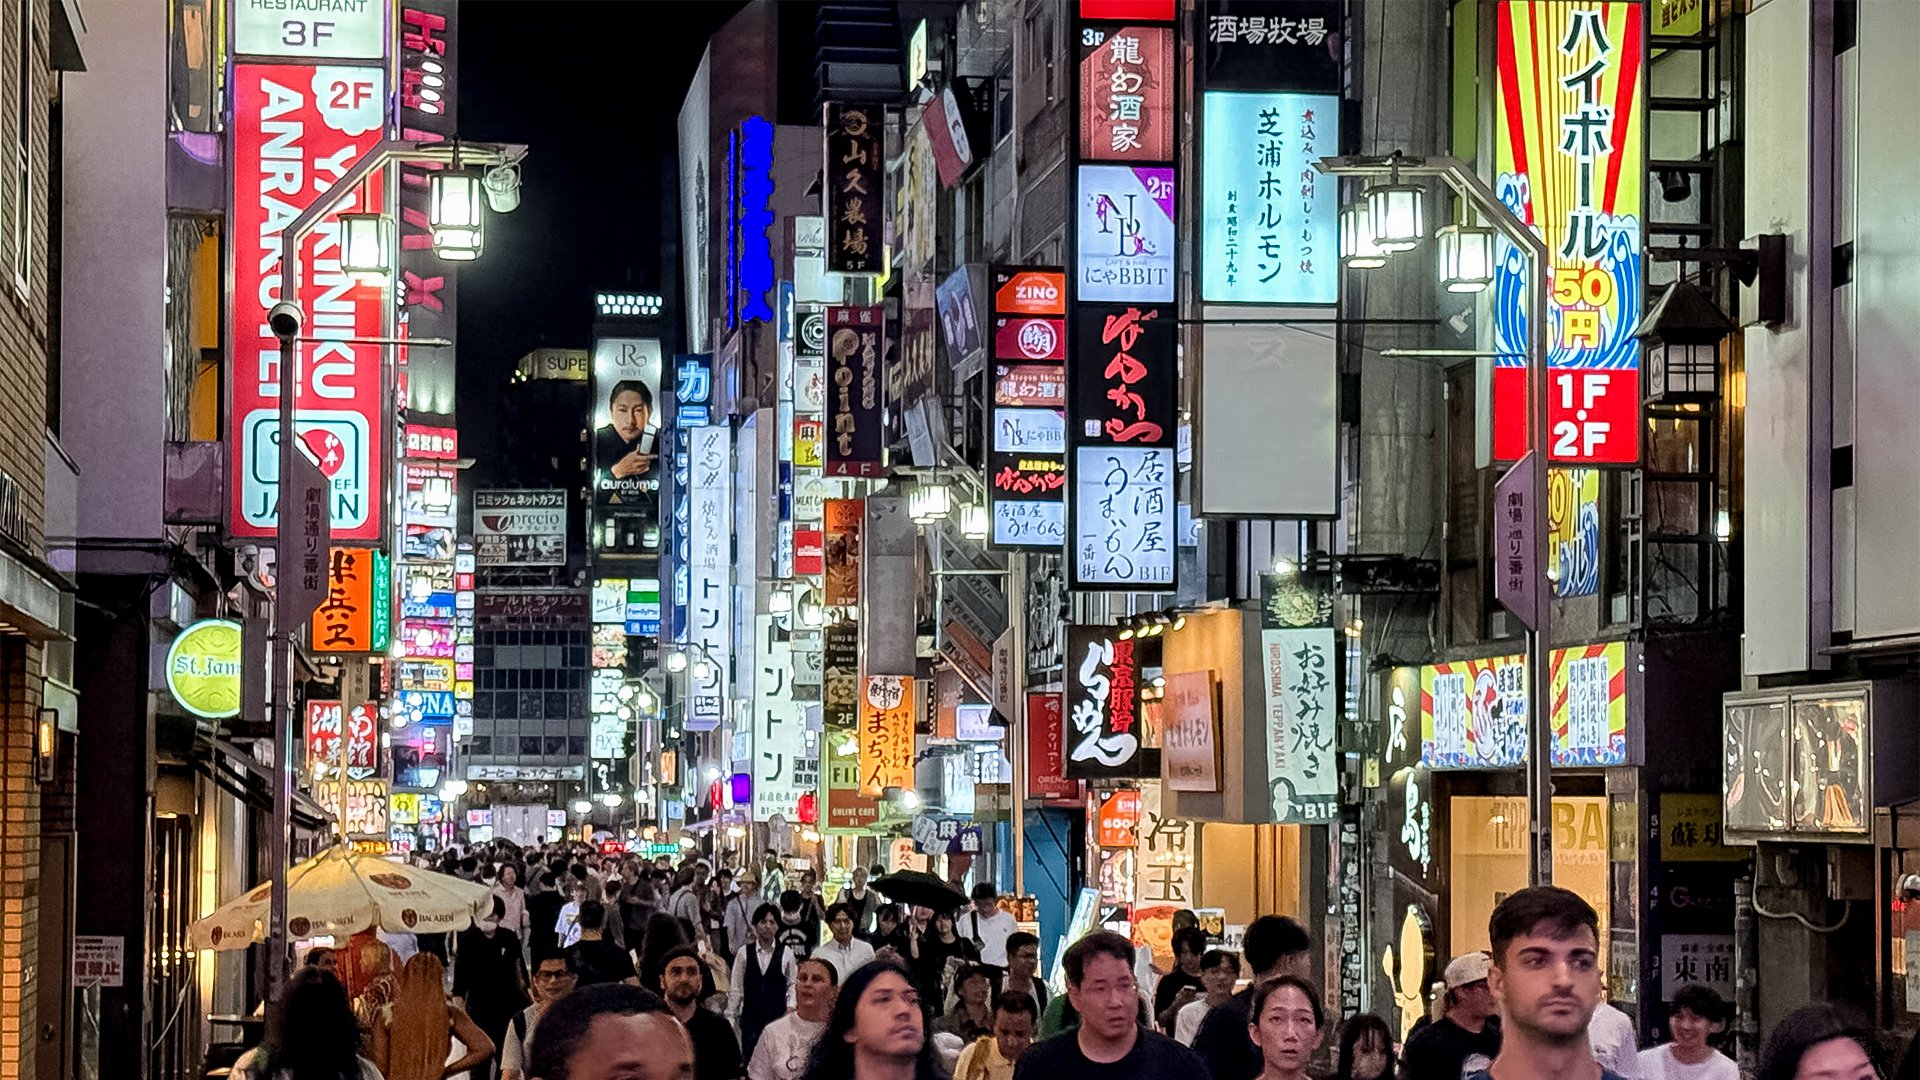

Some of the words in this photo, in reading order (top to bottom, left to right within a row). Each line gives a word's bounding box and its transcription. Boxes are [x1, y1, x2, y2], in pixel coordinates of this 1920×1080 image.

[282, 21, 335, 47] 3F
[1082, 30, 1103, 46] 3F
[1210, 16, 1328, 45] 酒場牧場
[330, 81, 374, 110] 2F
[1110, 36, 1144, 152] 龍幻酒家
[1560, 10, 1613, 260] ハイボール
[1148, 176, 1173, 200] 2F
[1257, 107, 1282, 284] 芝浦ホルモン
[846, 261, 866, 269] 5F
[1015, 286, 1058, 300] ZINO
[837, 311, 872, 324] 麻雀
[1562, 309, 1599, 349] 円
[547, 356, 587, 372] SUPE
[1557, 375, 1610, 409] 1F
[1553, 422, 1610, 456] 2F
[837, 464, 872, 475] 4F
[1133, 451, 1168, 552] 居酒屋
[303, 487, 321, 591] 劇場通り一番街
[1506, 492, 1522, 591] 劇場通り一番街
[1082, 534, 1097, 579] 一番街
[1110, 640, 1134, 733] 東京豚骨
[1269, 643, 1282, 698] HIROSHIMA
[838, 713, 854, 725] 2F
[1289, 642, 1333, 780] お好み焼き
[1272, 703, 1286, 769] TEPPANYAKI
[1304, 802, 1338, 820] B1F
[1552, 803, 1604, 850] BA
[1675, 955, 1730, 982] 東南
